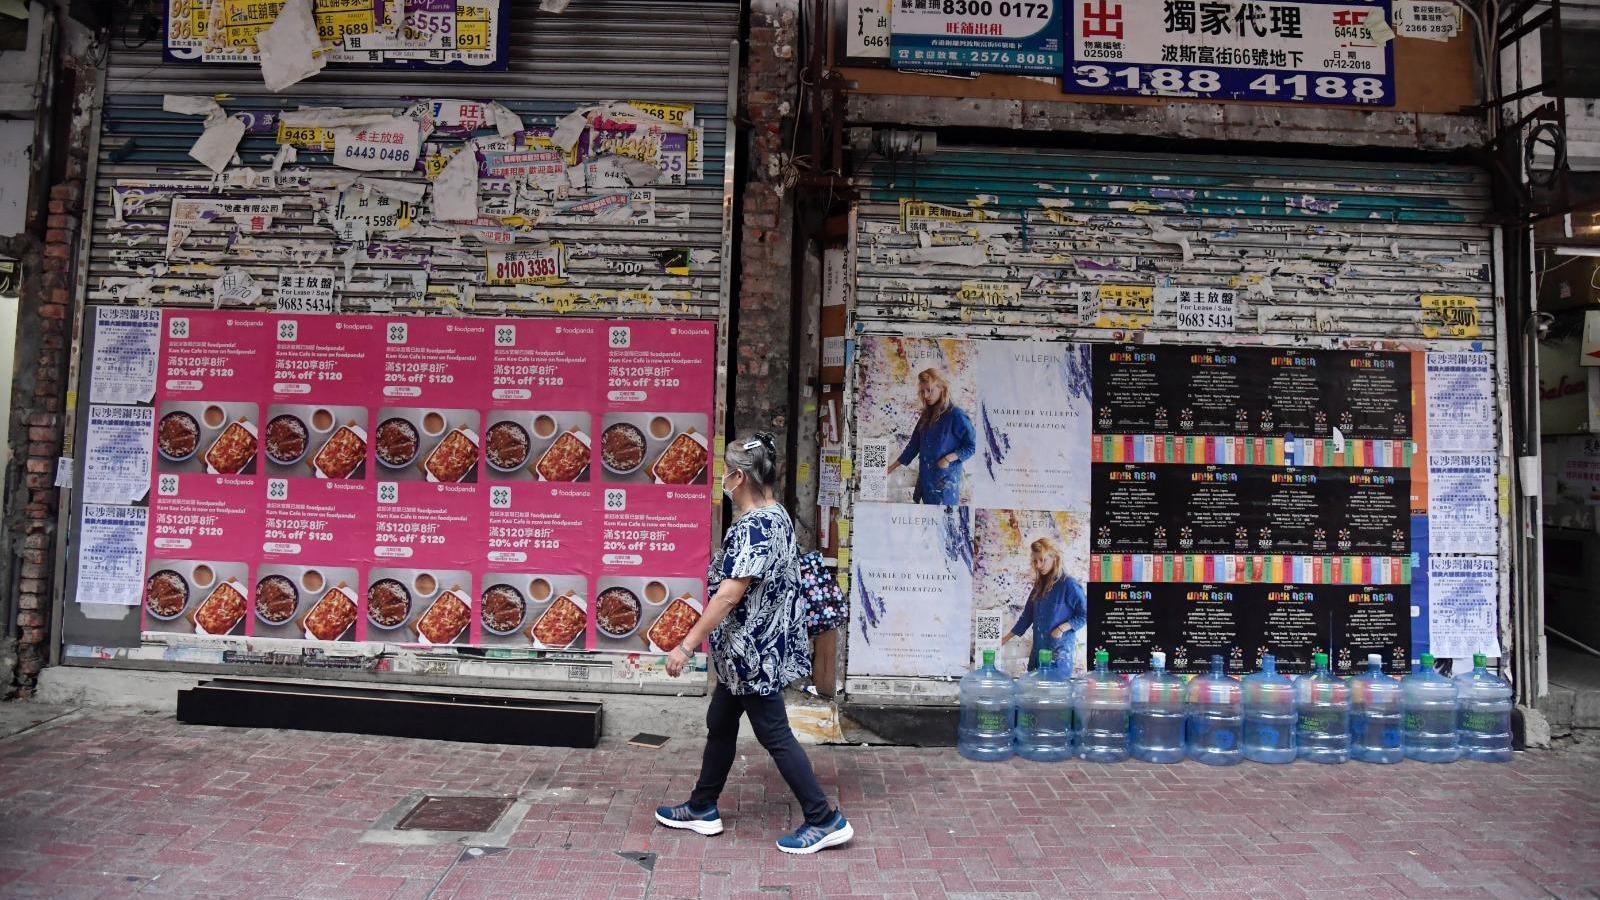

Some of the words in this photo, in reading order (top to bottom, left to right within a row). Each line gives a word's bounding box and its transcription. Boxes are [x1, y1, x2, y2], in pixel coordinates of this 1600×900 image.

[943, 0, 992, 16] 8300
[1000, 1, 1049, 19] 0172
[878, 17, 886, 27] 出
[1083, 0, 1123, 39] 出
[1163, 0, 1303, 38] 獨家代理
[350, 37, 361, 48] 租
[441, 36, 451, 48] 售
[970, 51, 1009, 62] 2576
[1017, 53, 1054, 64] 8081
[1084, 50, 1122, 58] 025098
[1161, 44, 1303, 68] 波斯富街66號地下
[1323, 59, 1371, 69] 07-12-2018
[1074, 65, 1222, 92] 3188
[1249, 73, 1385, 99] 4188
[285, 130, 316, 140] 9463
[355, 130, 405, 145] 業主放盤
[346, 146, 376, 159] 6443
[379, 149, 410, 161] 0486
[251, 216, 265, 230] 售
[496, 260, 524, 278] 8100
[527, 257, 556, 275] 3383
[282, 275, 332, 289] 業主放盤
[1179, 291, 1233, 304] 業主放盤
[278, 297, 302, 310] 9683
[306, 298, 331, 312] 5434
[234, 320, 263, 328] foodpanda
[1179, 312, 1204, 327] 9683
[1208, 313, 1233, 328] 5434
[454, 325, 485, 333] foodpanda
[1015, 354, 1060, 363] VILLEPIN
[168, 368, 188, 376] 20%
[209, 368, 234, 377] $120
[275, 371, 295, 379] 20%
[318, 371, 342, 380] $120
[385, 374, 406, 382] 20%
[429, 375, 453, 383] $120
[494, 376, 515, 385] 20%
[538, 377, 563, 386] $120
[608, 379, 630, 387] 20%
[654, 379, 680, 387] $120
[993, 408, 1018, 417] MARIE
[1024, 408, 1034, 417] DE
[1040, 410, 1080, 418] VILLEPIN
[1005, 421, 1066, 430] MURMURATION
[223, 478, 254, 486] foodpanda
[559, 489, 590, 497] foodpanda
[674, 491, 706, 499] foodpanda
[891, 516, 938, 526] VILLEPIN
[156, 526, 177, 534] 20%
[199, 526, 223, 535] $120
[265, 530, 286, 538] 20%
[308, 532, 333, 541] $120
[376, 534, 397, 542] 20%
[420, 535, 445, 544] $120
[489, 539, 511, 547] 20%
[534, 540, 559, 549] $120
[603, 542, 626, 550] 20%
[649, 543, 675, 551] $120
[868, 571, 896, 580] MARIE
[901, 572, 911, 580] DE
[916, 573, 957, 581] VILLEPIN
[881, 585, 943, 593] MURMURATION
